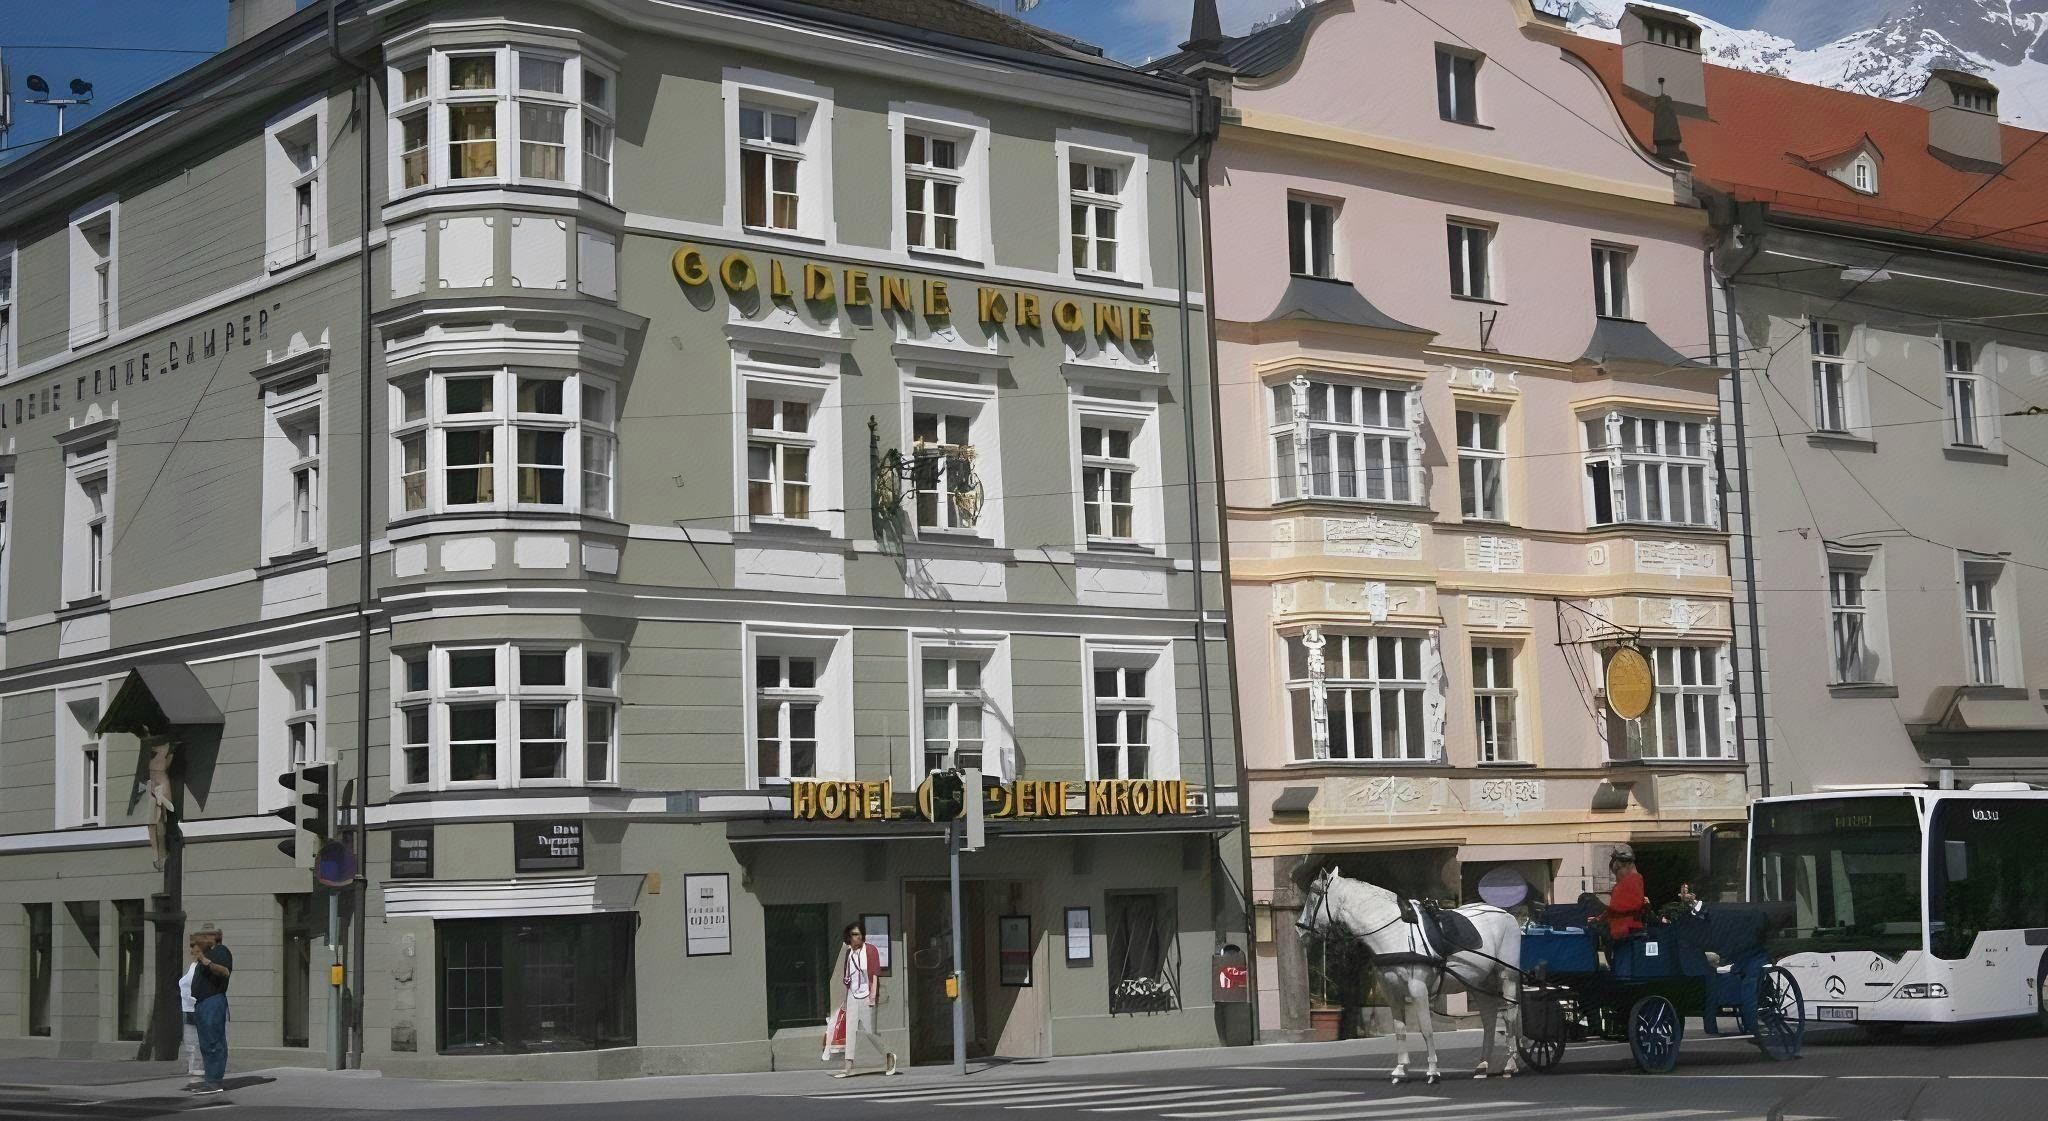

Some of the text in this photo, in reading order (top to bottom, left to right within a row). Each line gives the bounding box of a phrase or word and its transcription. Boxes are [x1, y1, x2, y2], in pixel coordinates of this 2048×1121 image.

[672, 246, 1153, 341] GOLDENE KRONE
[791, 779, 1197, 820] HOTEL DENE KRONE
